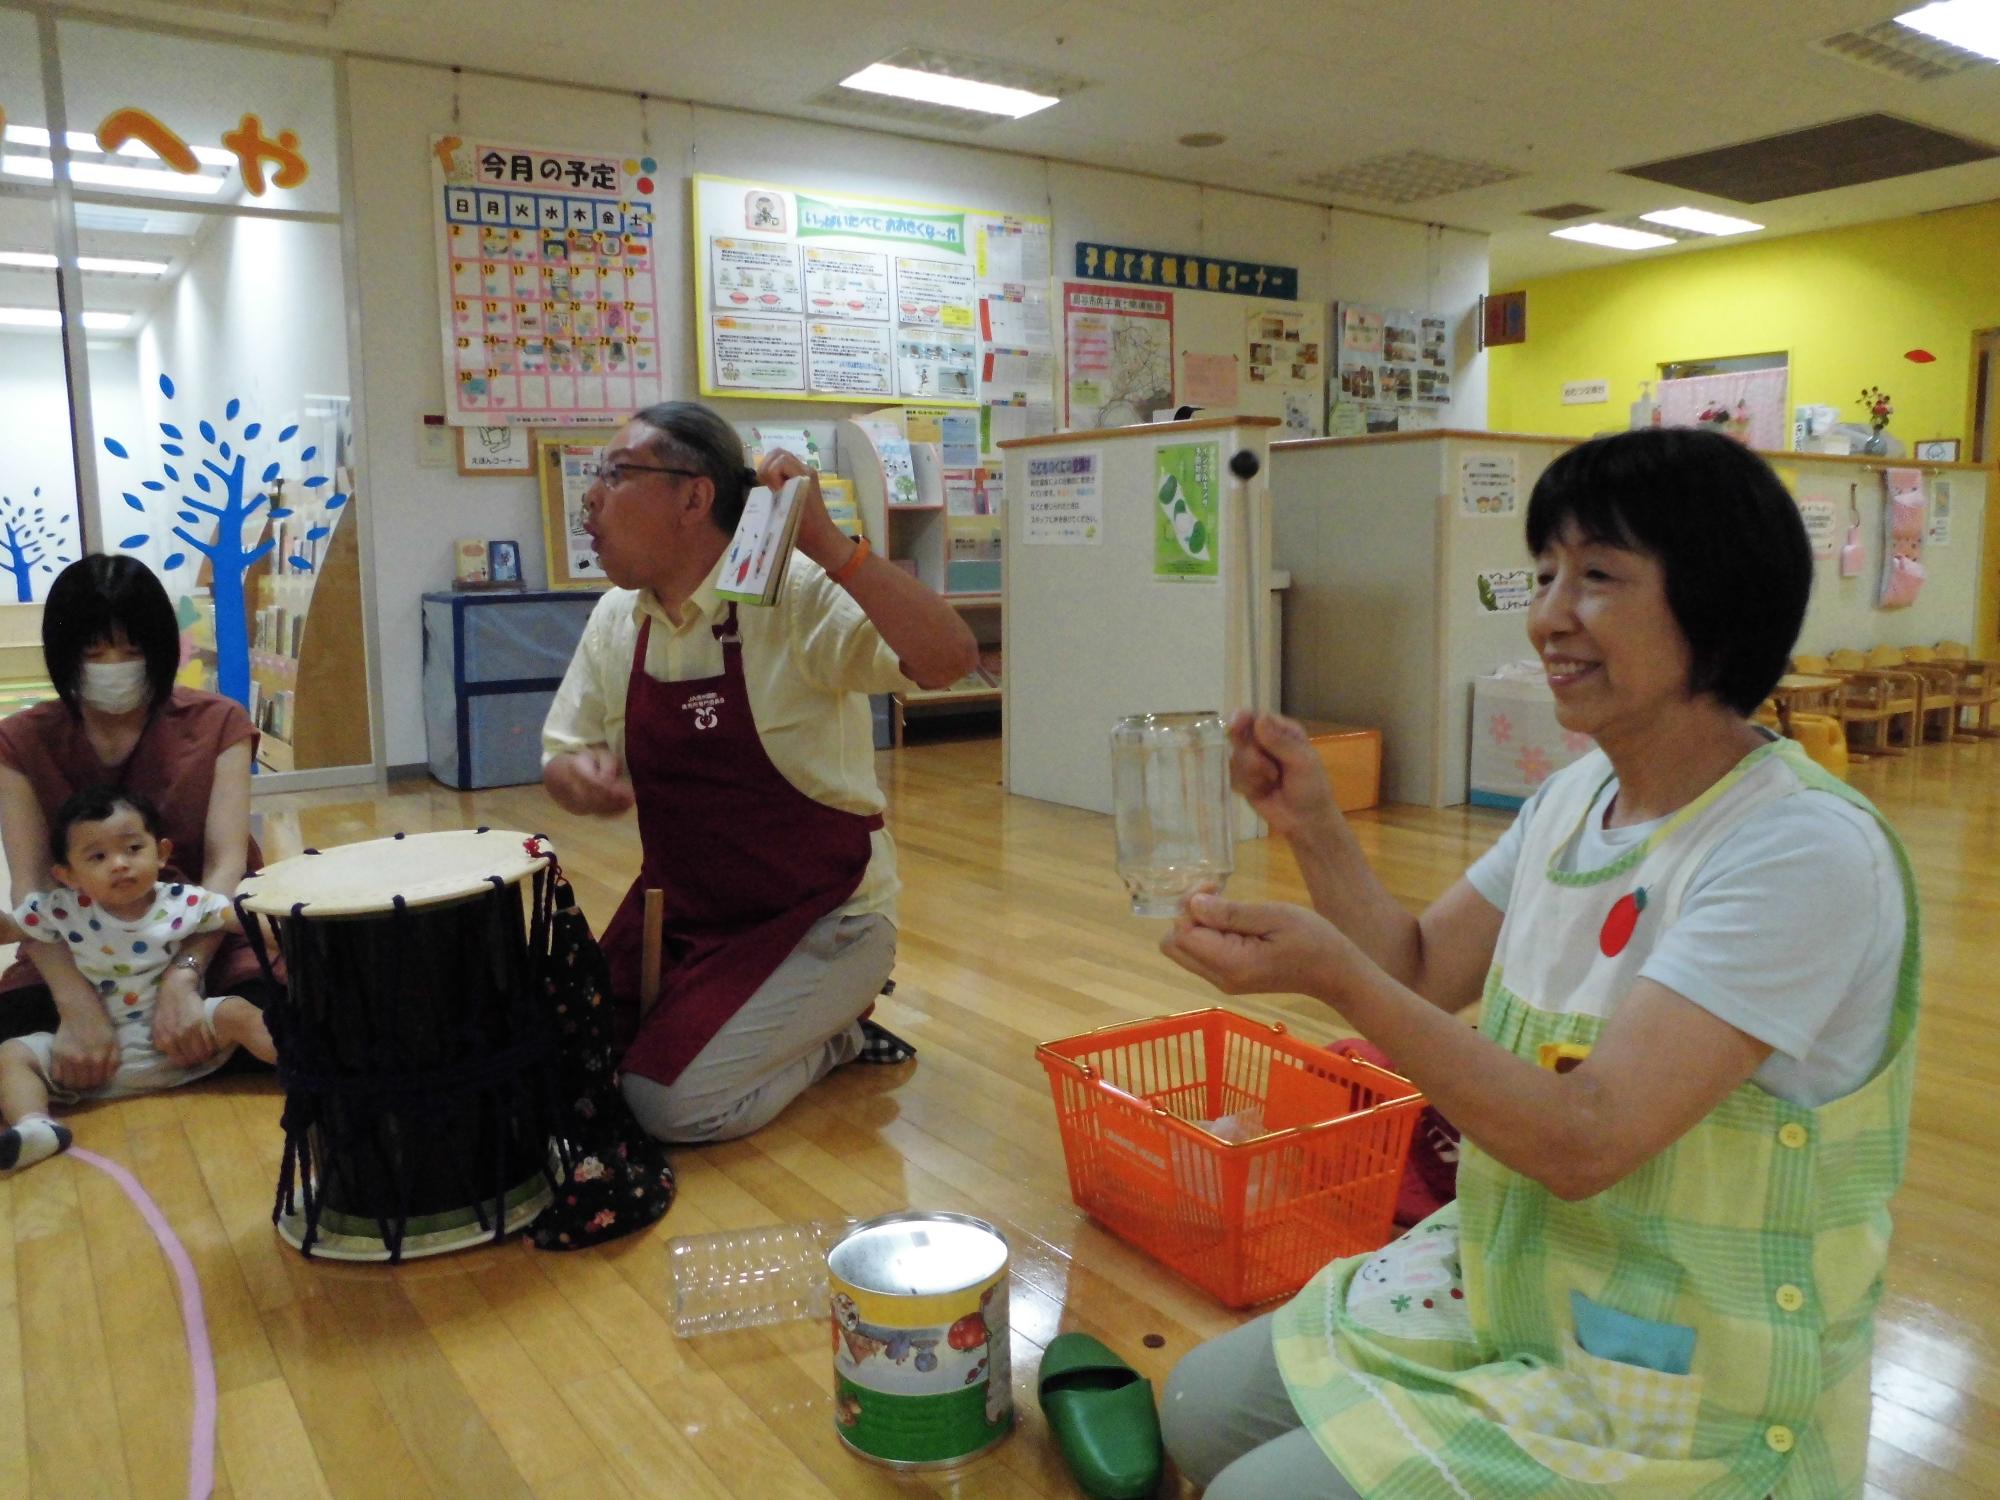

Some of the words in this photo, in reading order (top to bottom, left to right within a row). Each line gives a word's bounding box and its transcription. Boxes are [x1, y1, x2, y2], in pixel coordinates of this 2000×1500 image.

[482, 152, 616, 190] 今月の予定
[456, 199, 469, 213] 日
[487, 201, 499, 215] 月
[515, 204, 529, 217] 火
[545, 206, 558, 220] 水
[573, 208, 588, 222] 木
[602, 211, 615, 224] 金
[631, 214, 642, 226] 土
[472, 456, 521, 465] えほんコーナー
